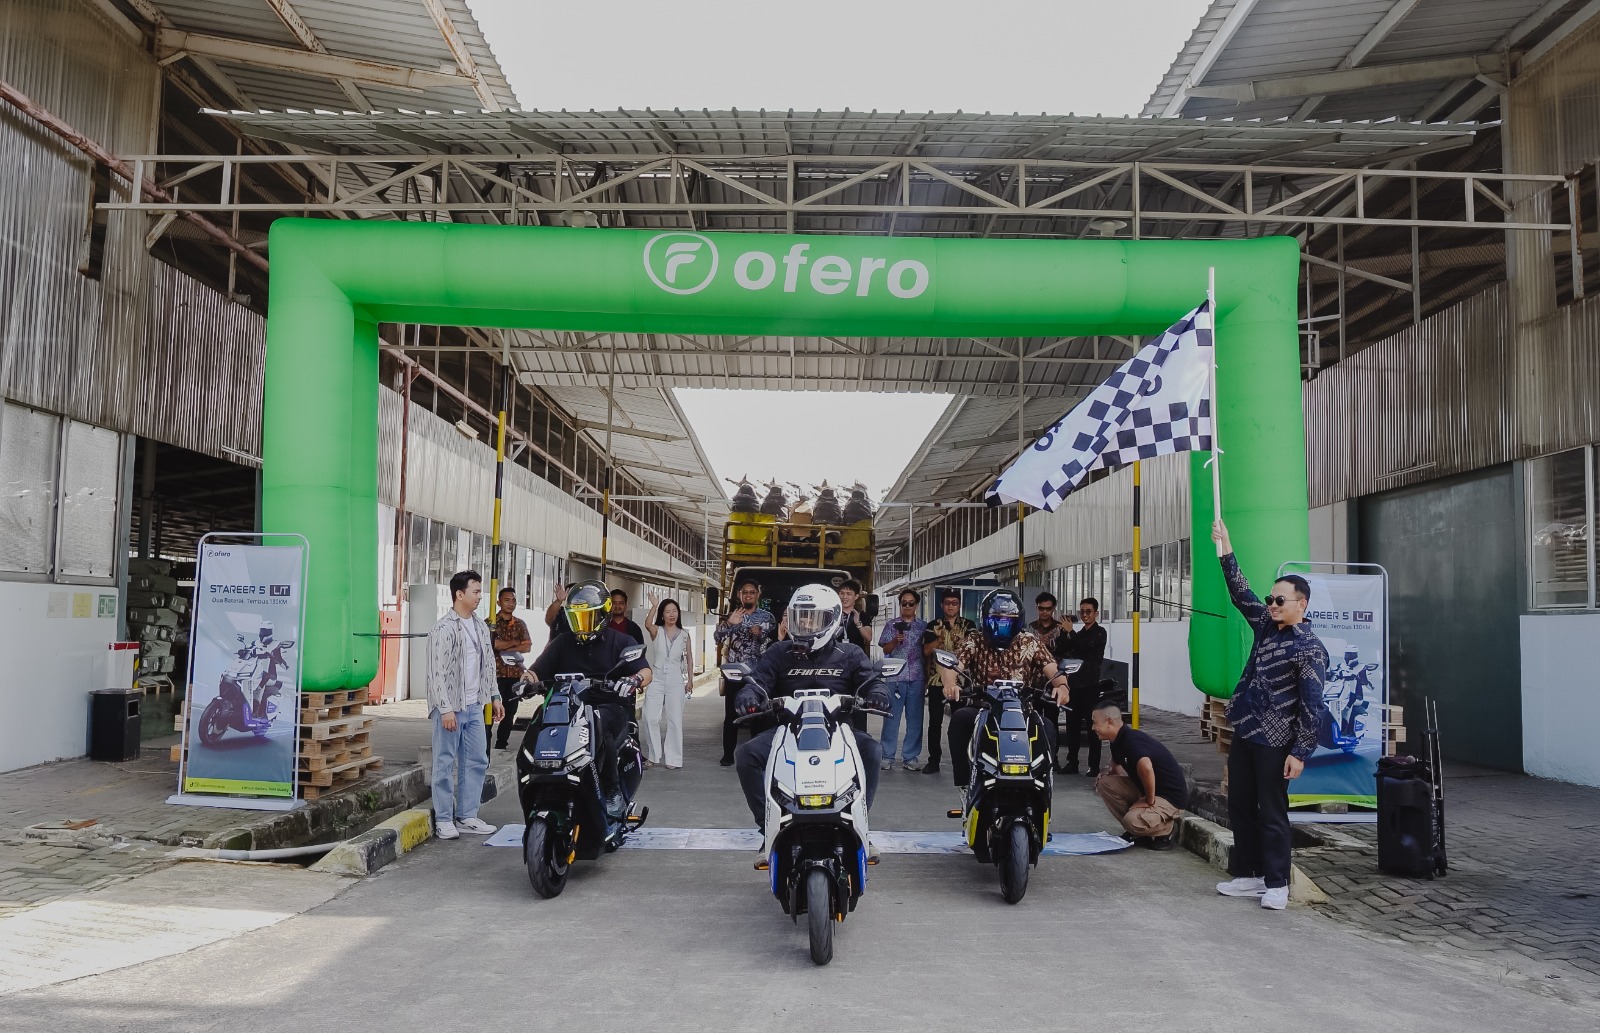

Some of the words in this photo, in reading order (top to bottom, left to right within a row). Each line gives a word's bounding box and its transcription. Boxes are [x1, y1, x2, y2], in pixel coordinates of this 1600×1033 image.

[734, 244, 929, 298] ofero
[210, 584, 256, 594] STAREER
[259, 586, 266, 594] 5
[1306, 610, 1339, 620] AREER
[1342, 612, 1349, 620] 5
